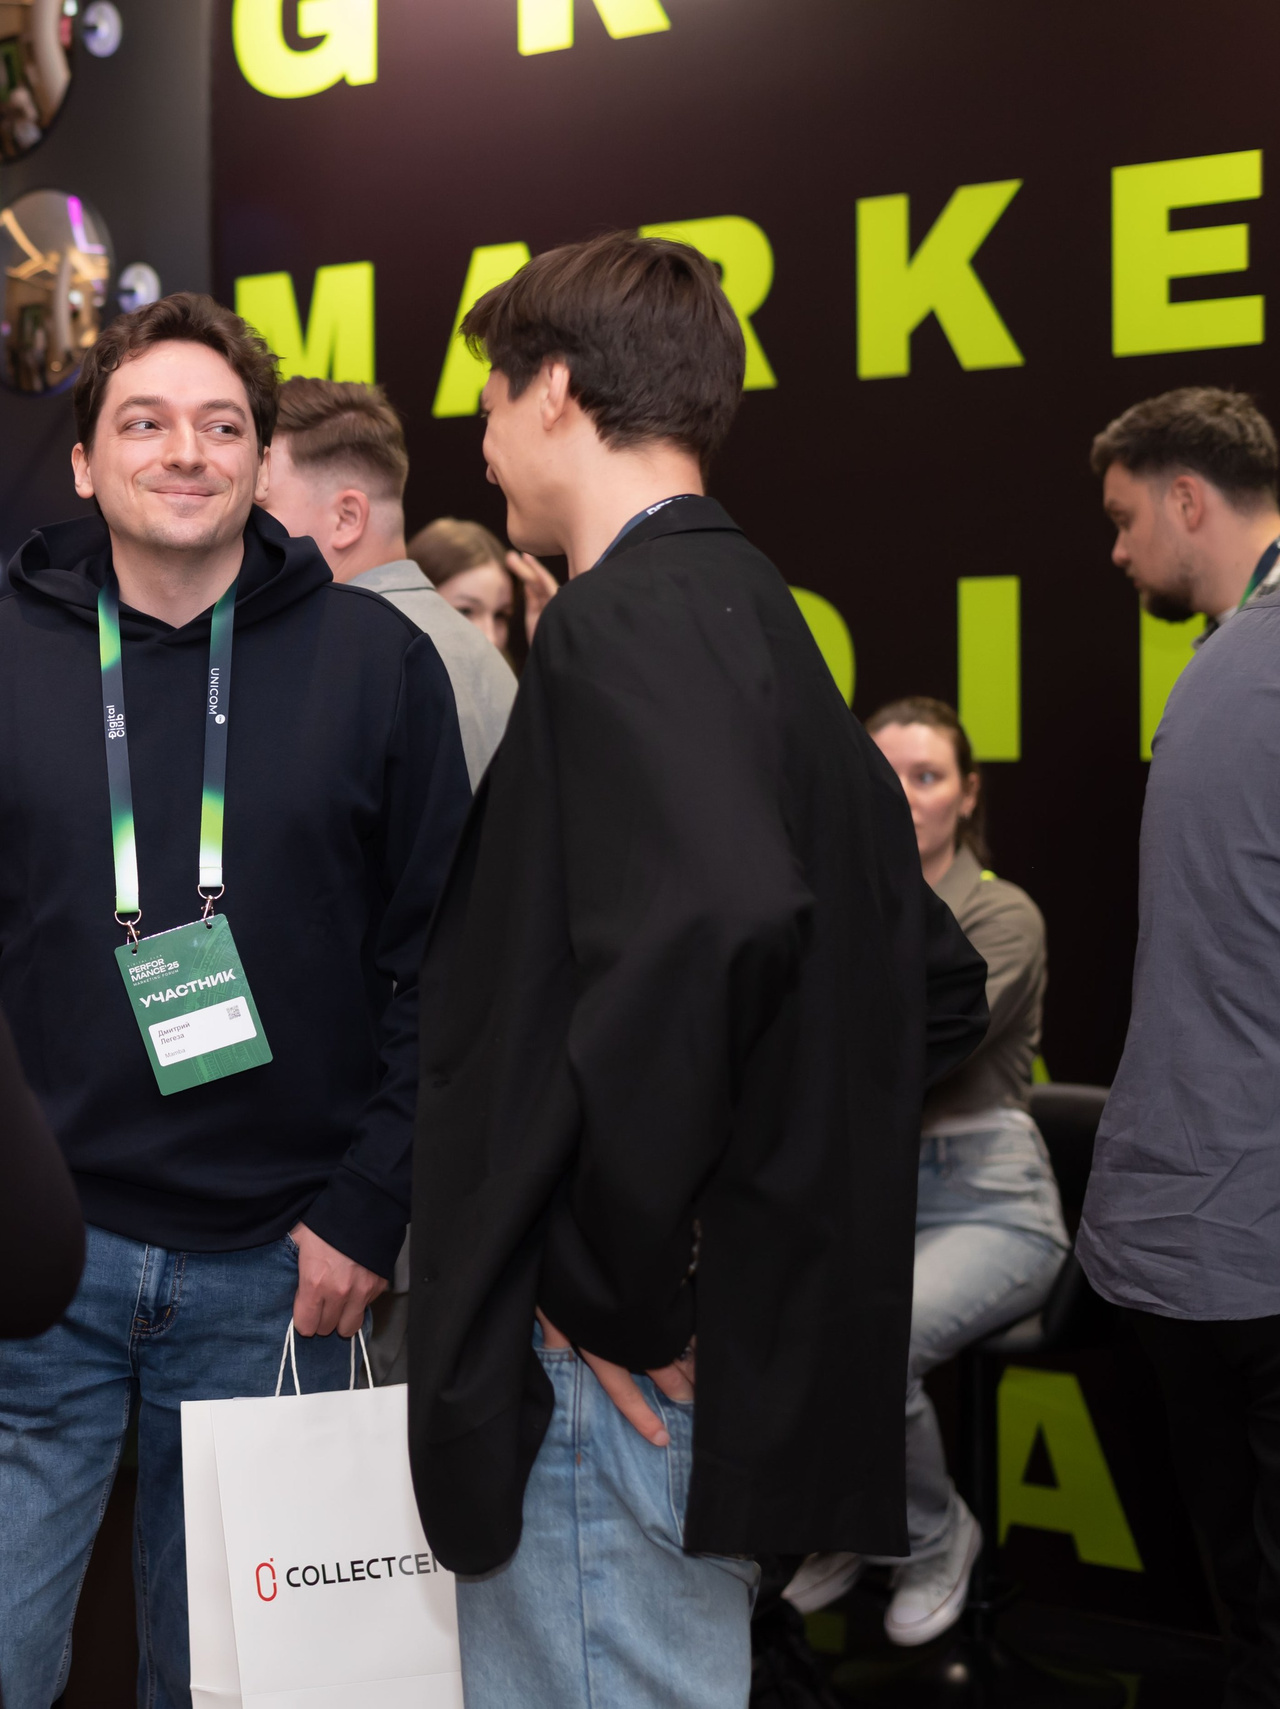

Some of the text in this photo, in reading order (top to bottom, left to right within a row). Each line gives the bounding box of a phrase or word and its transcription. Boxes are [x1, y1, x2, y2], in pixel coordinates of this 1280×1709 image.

[208, 667, 220, 715] UNICOM
[128, 958, 165, 975] PERFOR
[139, 968, 237, 1008] УЧАСТНИК
[157, 1021, 191, 1038] Дмитрий
